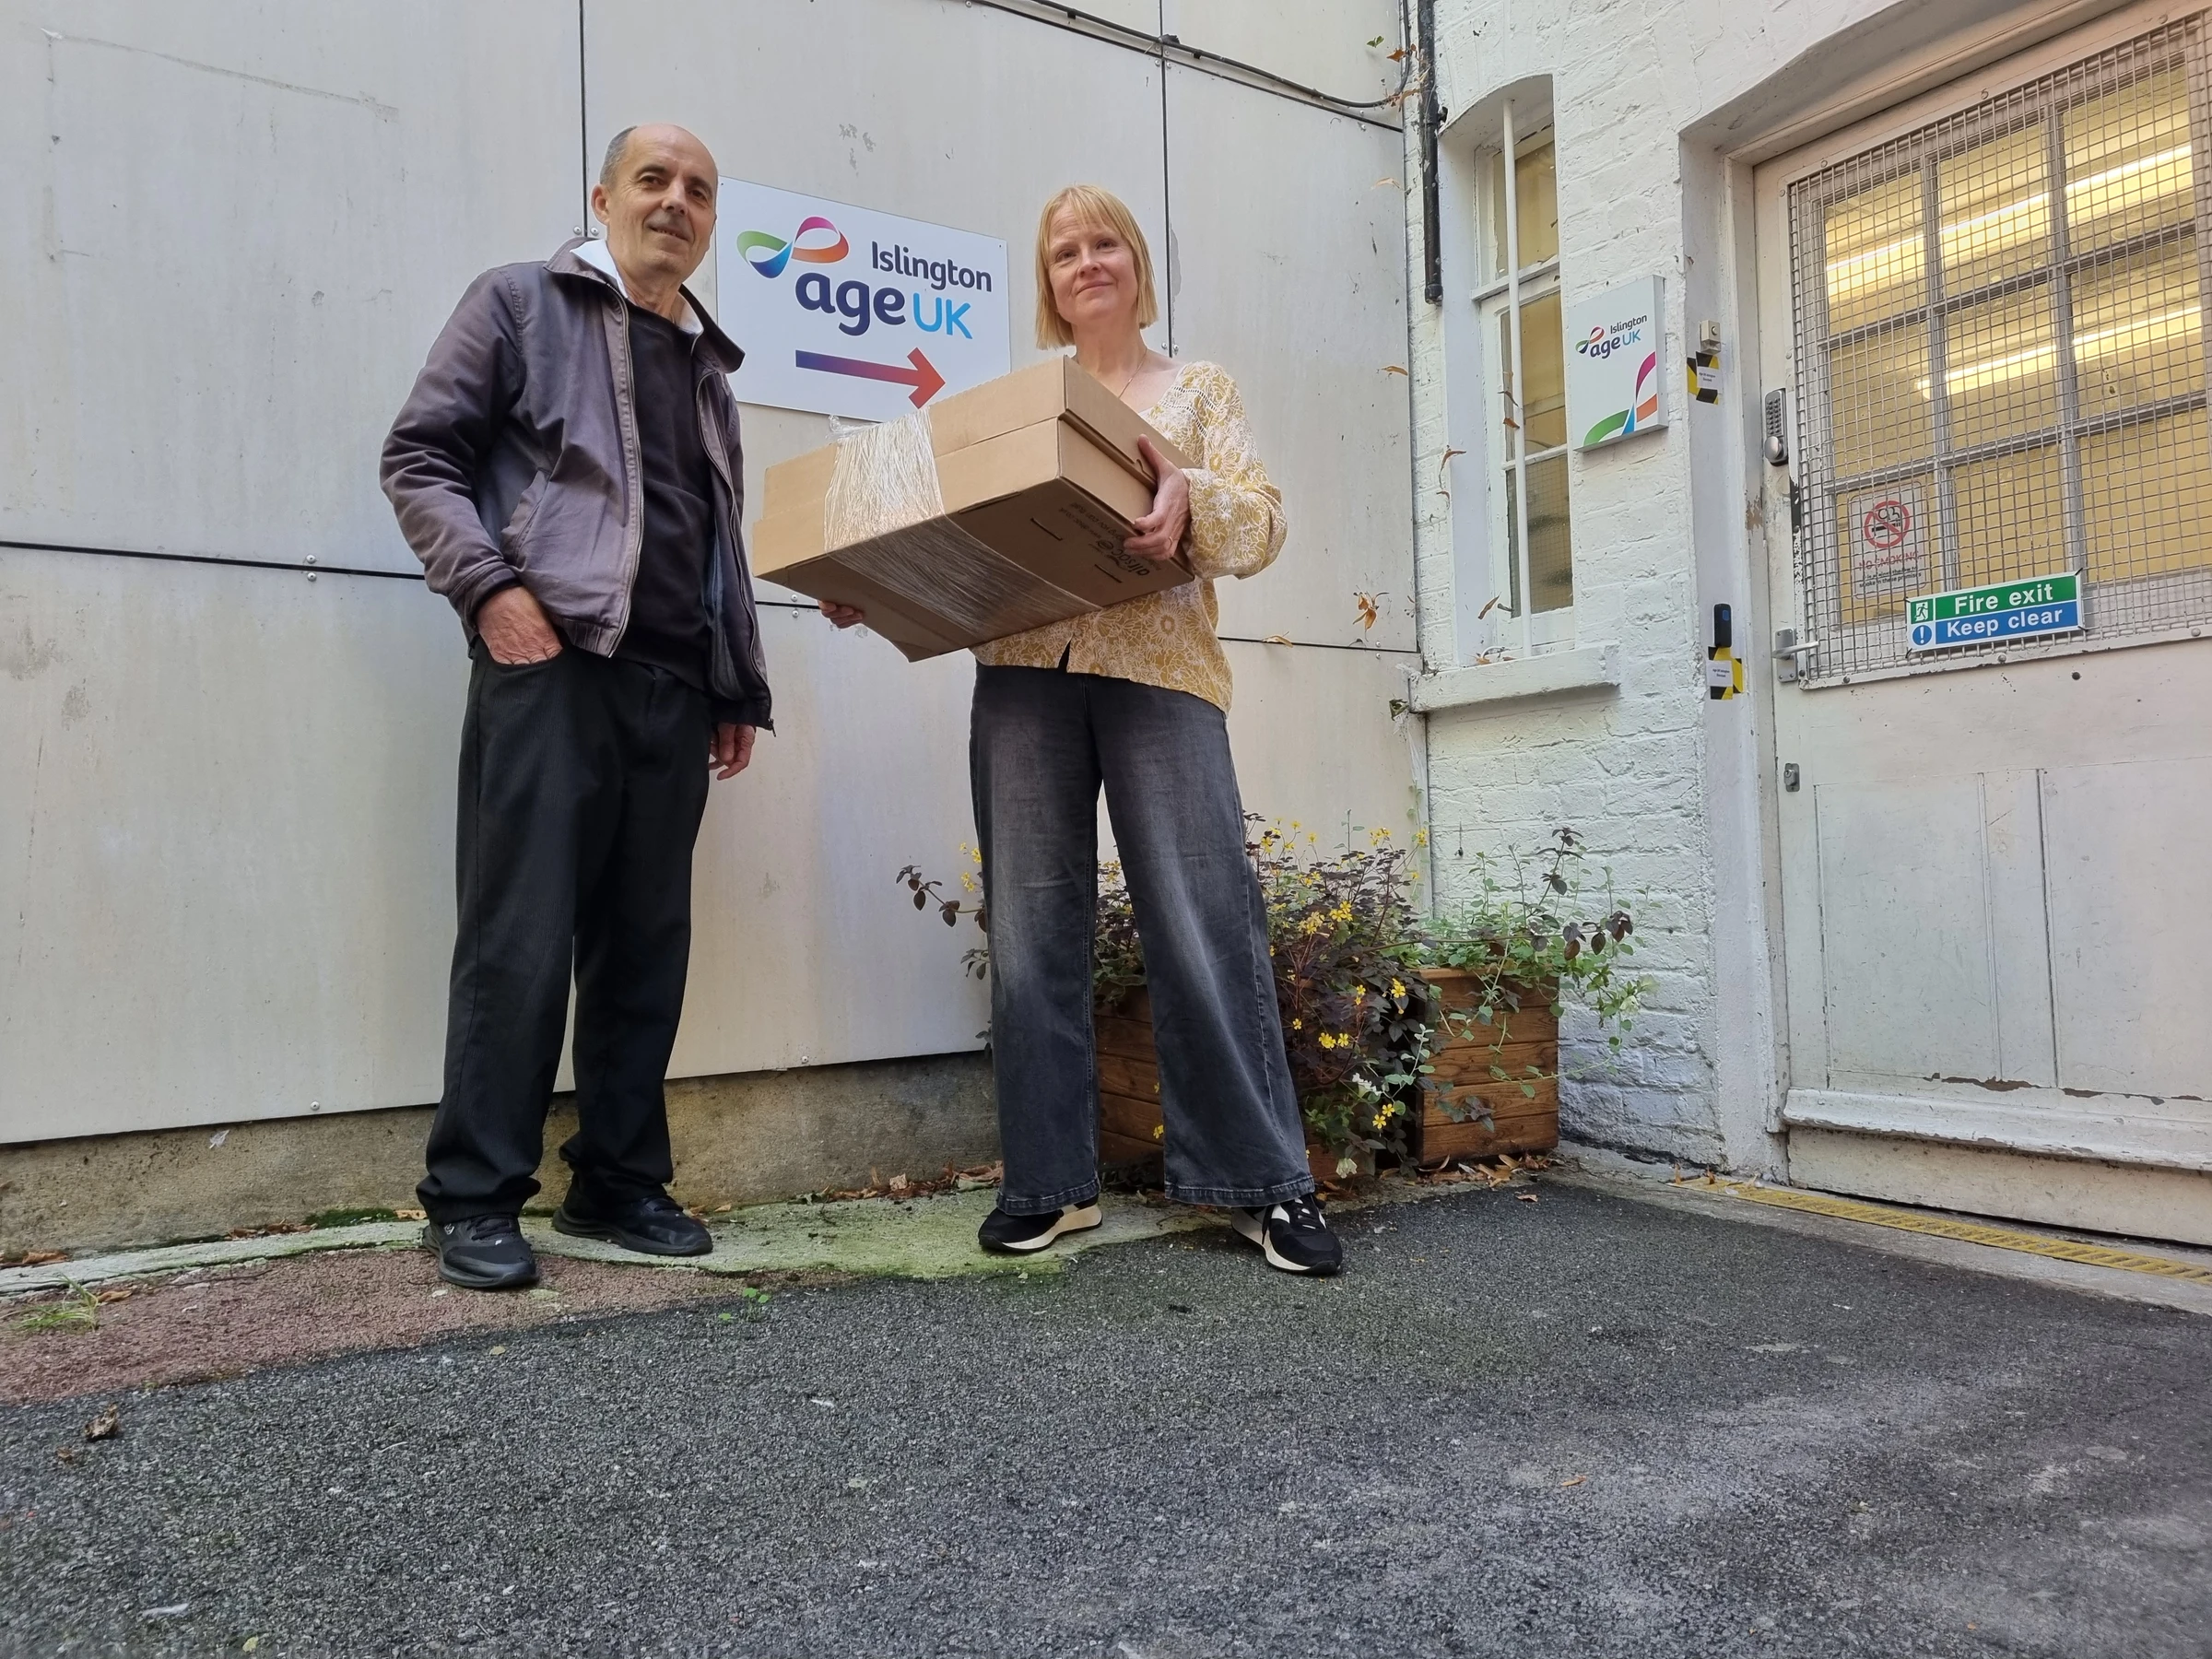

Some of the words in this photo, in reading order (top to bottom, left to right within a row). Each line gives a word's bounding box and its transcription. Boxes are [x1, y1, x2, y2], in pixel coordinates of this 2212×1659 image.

[871, 241, 992, 293] Islington
[794, 272, 907, 336] age
[912, 292, 973, 340] UK
[1610, 315, 1647, 334] Islington
[1590, 335, 1621, 359] age
[1622, 329, 1641, 347] UK
[1876, 551, 1923, 568] SMOKNG.
[1954, 595, 1999, 615] Fire
[2008, 582, 2053, 606] exit
[1947, 618, 1999, 638] Keep
[2007, 607, 2063, 629] clear
